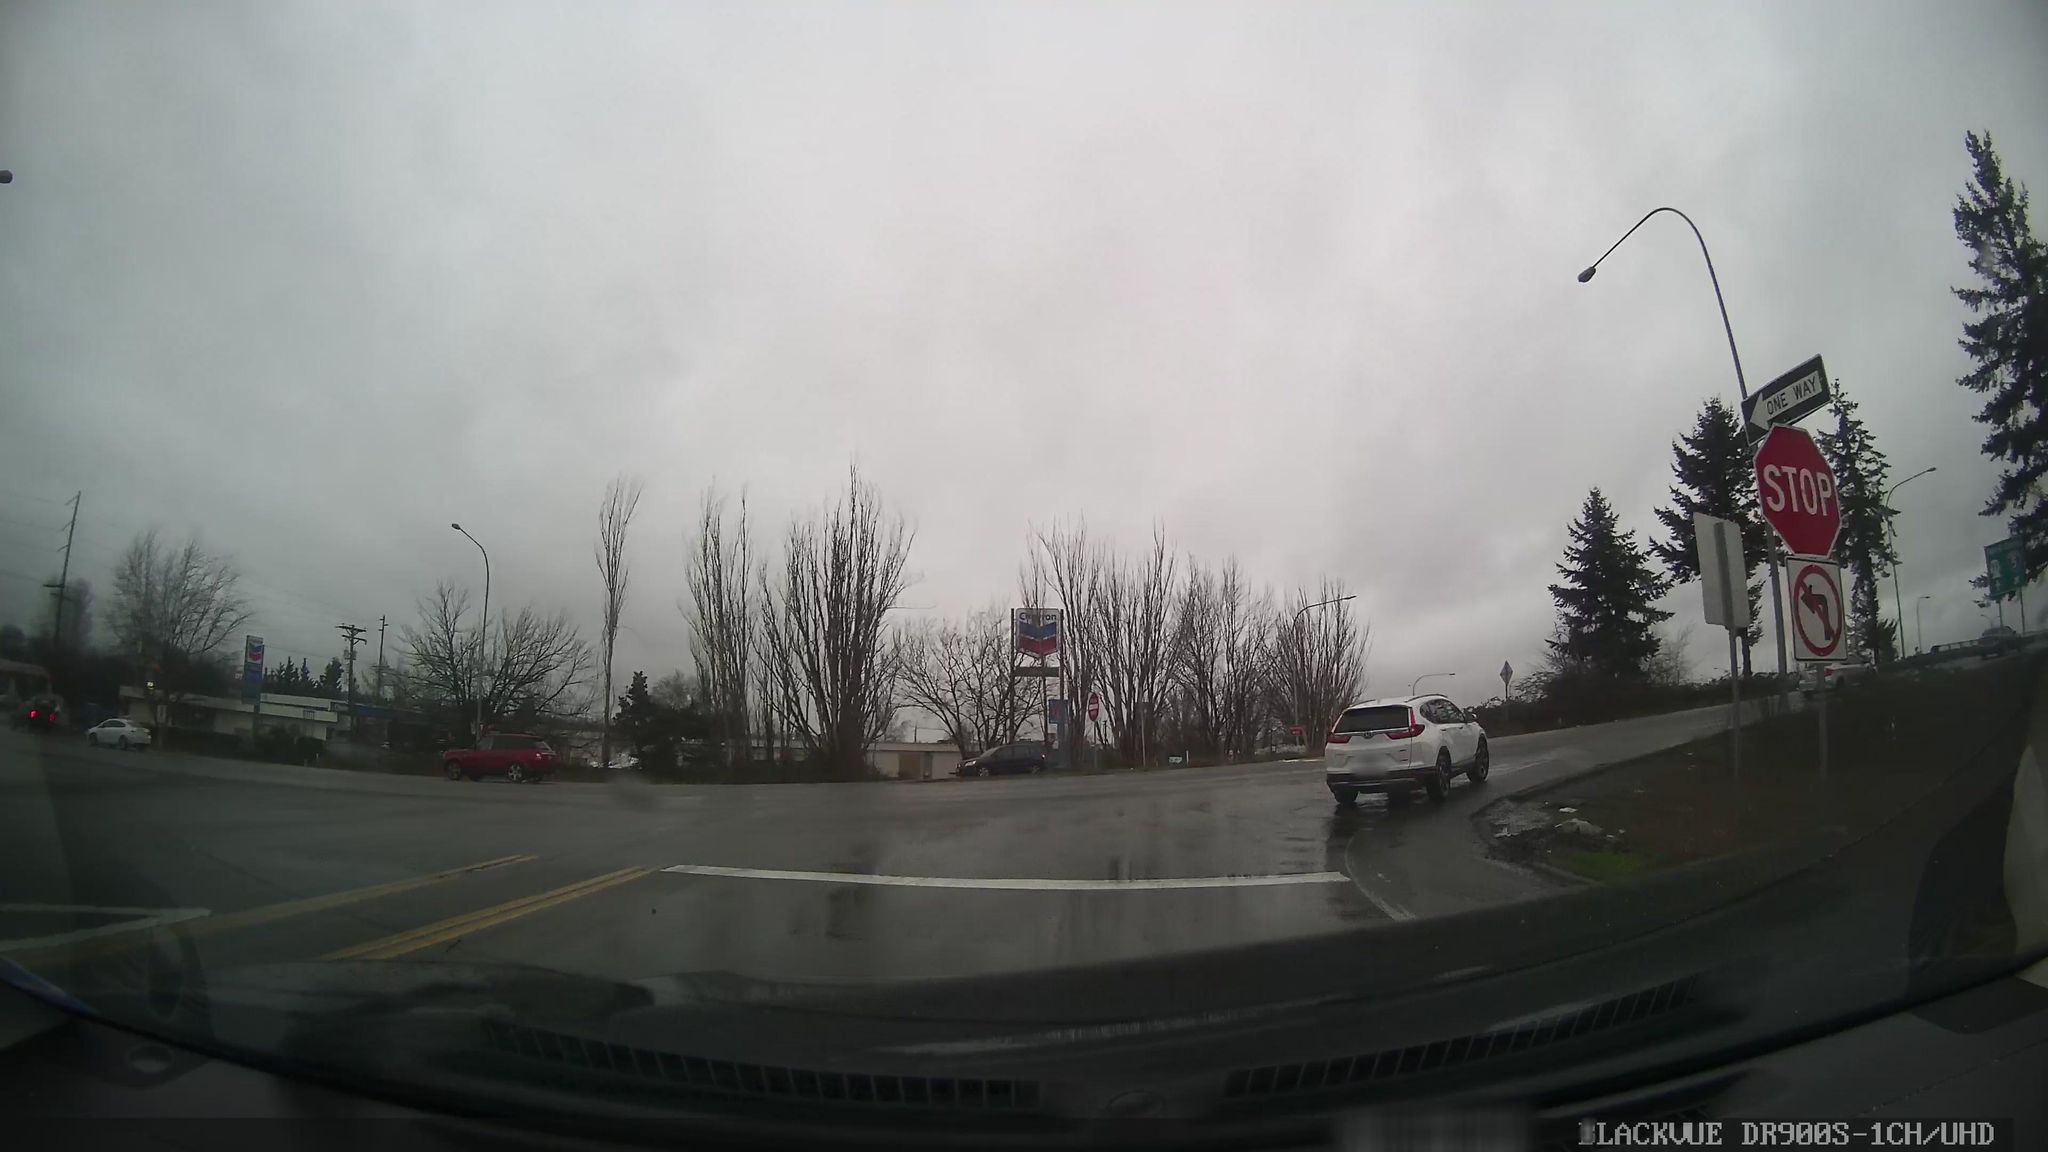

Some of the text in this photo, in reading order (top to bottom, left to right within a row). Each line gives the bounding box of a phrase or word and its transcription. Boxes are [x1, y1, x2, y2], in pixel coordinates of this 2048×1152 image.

[1767, 376, 1816, 415] ONE WAY
[1763, 464, 1831, 517] STOP
[1019, 612, 1057, 622] Cron
